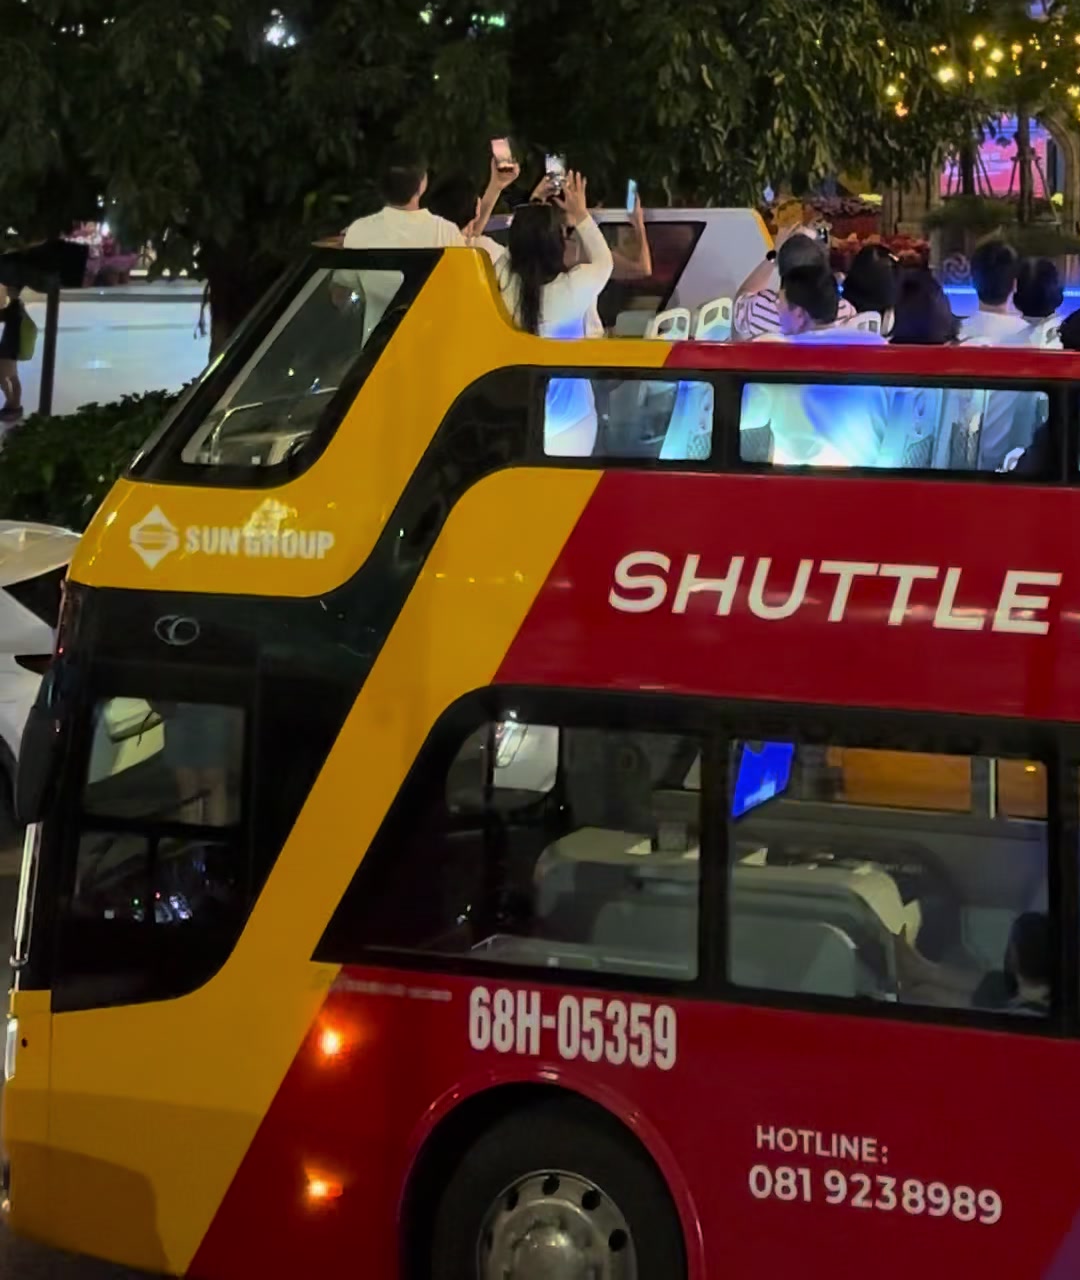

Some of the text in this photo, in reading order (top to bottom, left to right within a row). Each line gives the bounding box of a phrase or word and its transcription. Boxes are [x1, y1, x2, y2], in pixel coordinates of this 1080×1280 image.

[185, 525, 335, 560] SUN GROUP
[608, 550, 1063, 635] SHUTTLE
[468, 985, 678, 1072] 68H-05359
[755, 1124, 889, 1165] HOTLINE:
[748, 1164, 1003, 1225] 081 9238989
